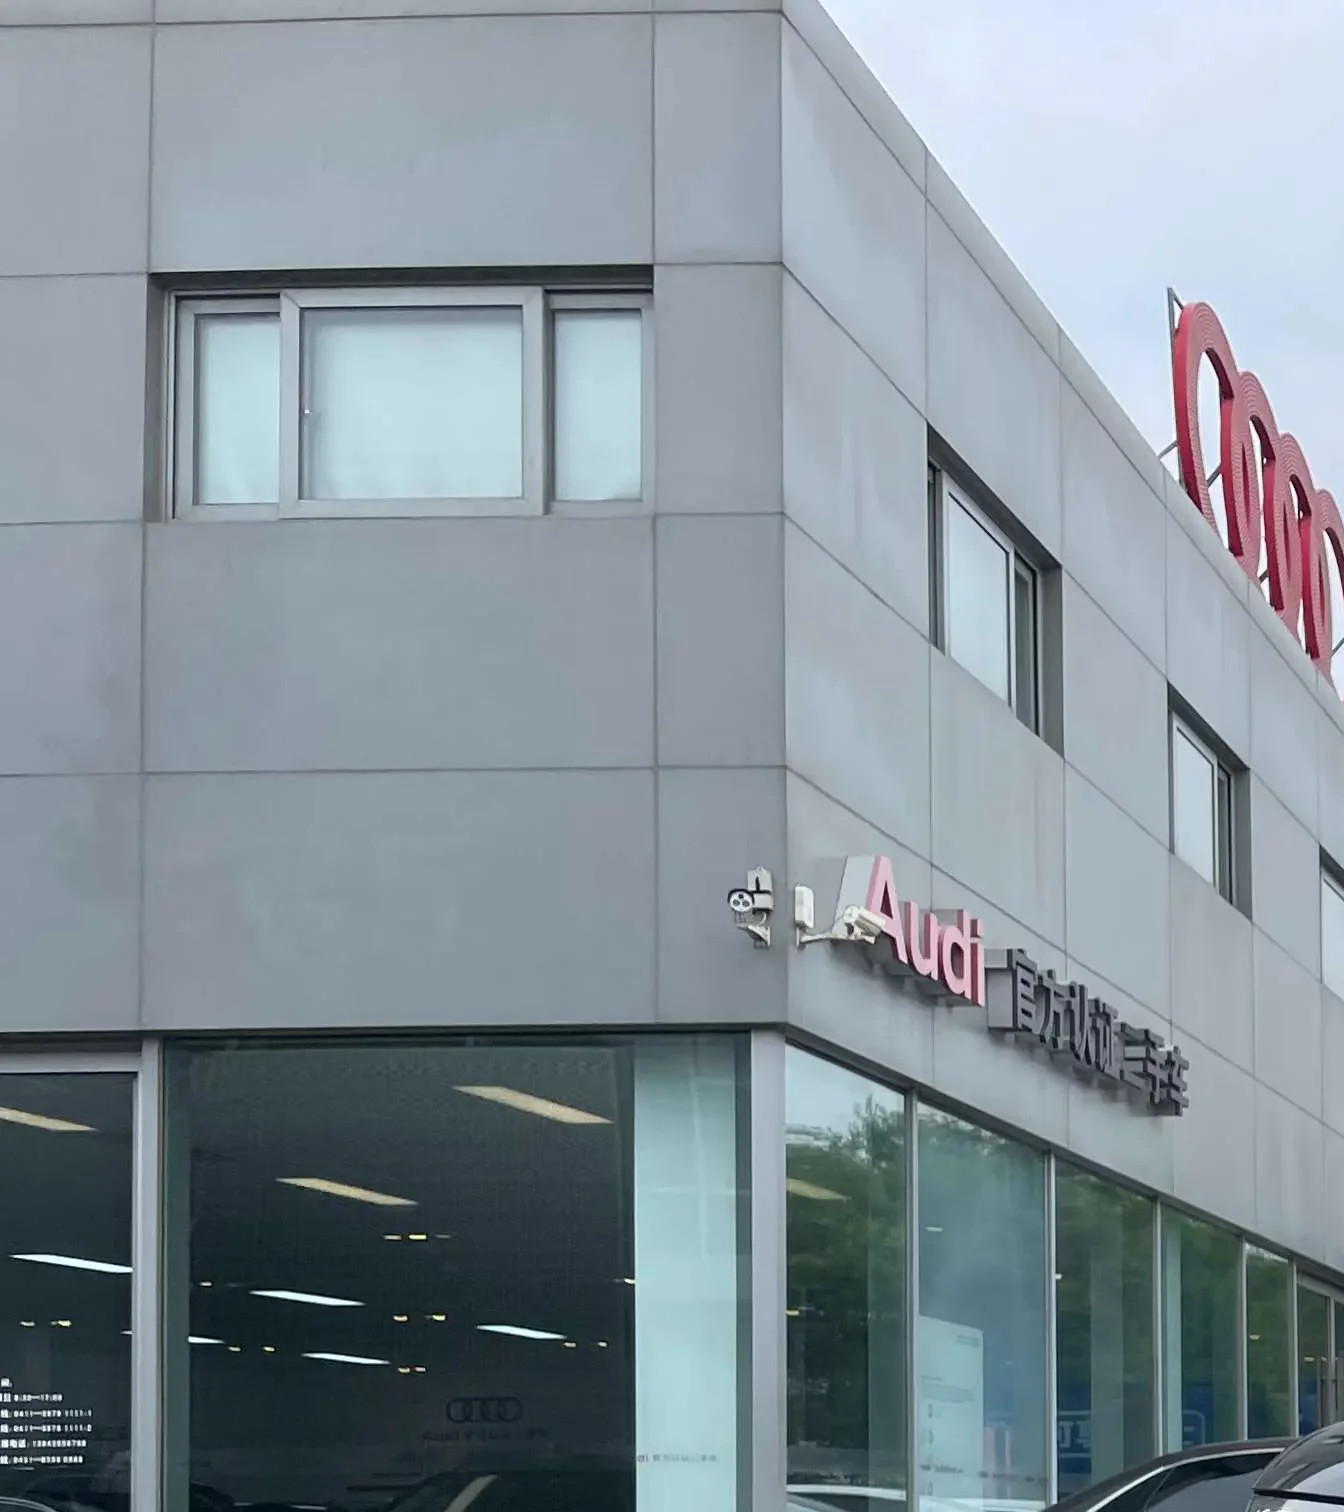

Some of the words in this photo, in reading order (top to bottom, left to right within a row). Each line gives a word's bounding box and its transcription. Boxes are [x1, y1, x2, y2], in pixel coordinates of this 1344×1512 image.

[866, 855, 985, 1007] Audi
[1007, 948, 1190, 1117] 官方认证二手车
